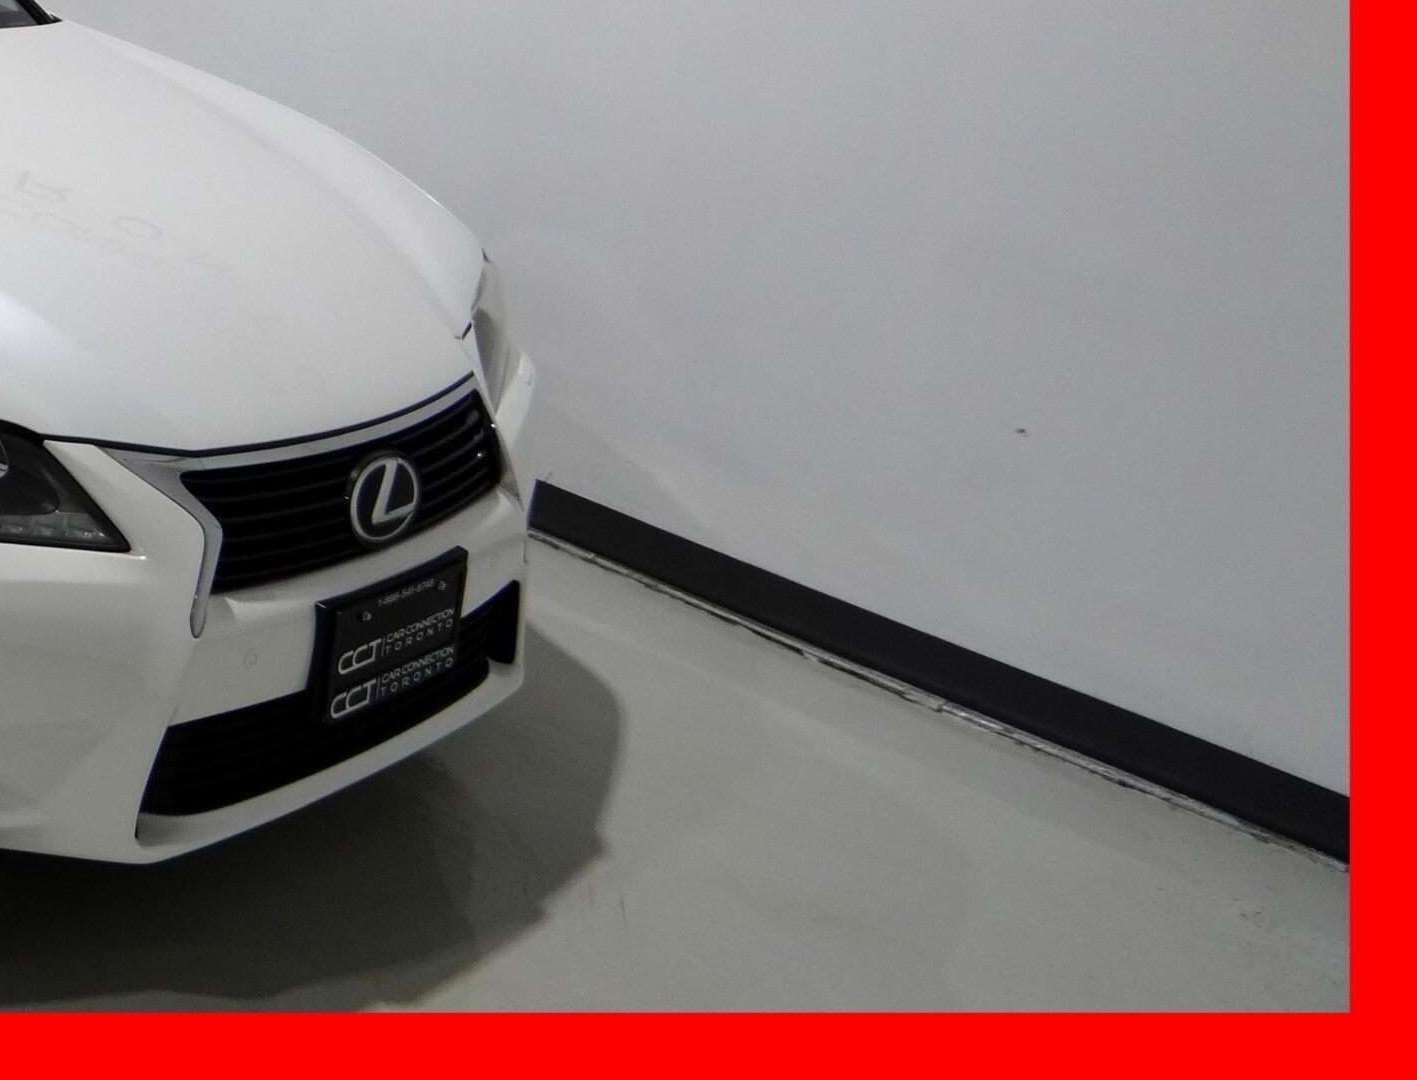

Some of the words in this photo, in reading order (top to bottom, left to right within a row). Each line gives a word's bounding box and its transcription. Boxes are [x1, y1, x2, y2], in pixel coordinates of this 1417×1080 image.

[385, 618, 454, 655] TORONTO
[386, 624, 405, 643] CAR
[406, 607, 455, 634] CONNECTION
[338, 638, 382, 675] CCT
[381, 666, 400, 684] CAR
[402, 646, 455, 676] CONNECTION
[380, 657, 454, 697] TORONTO
[330, 678, 377, 718] CCT
